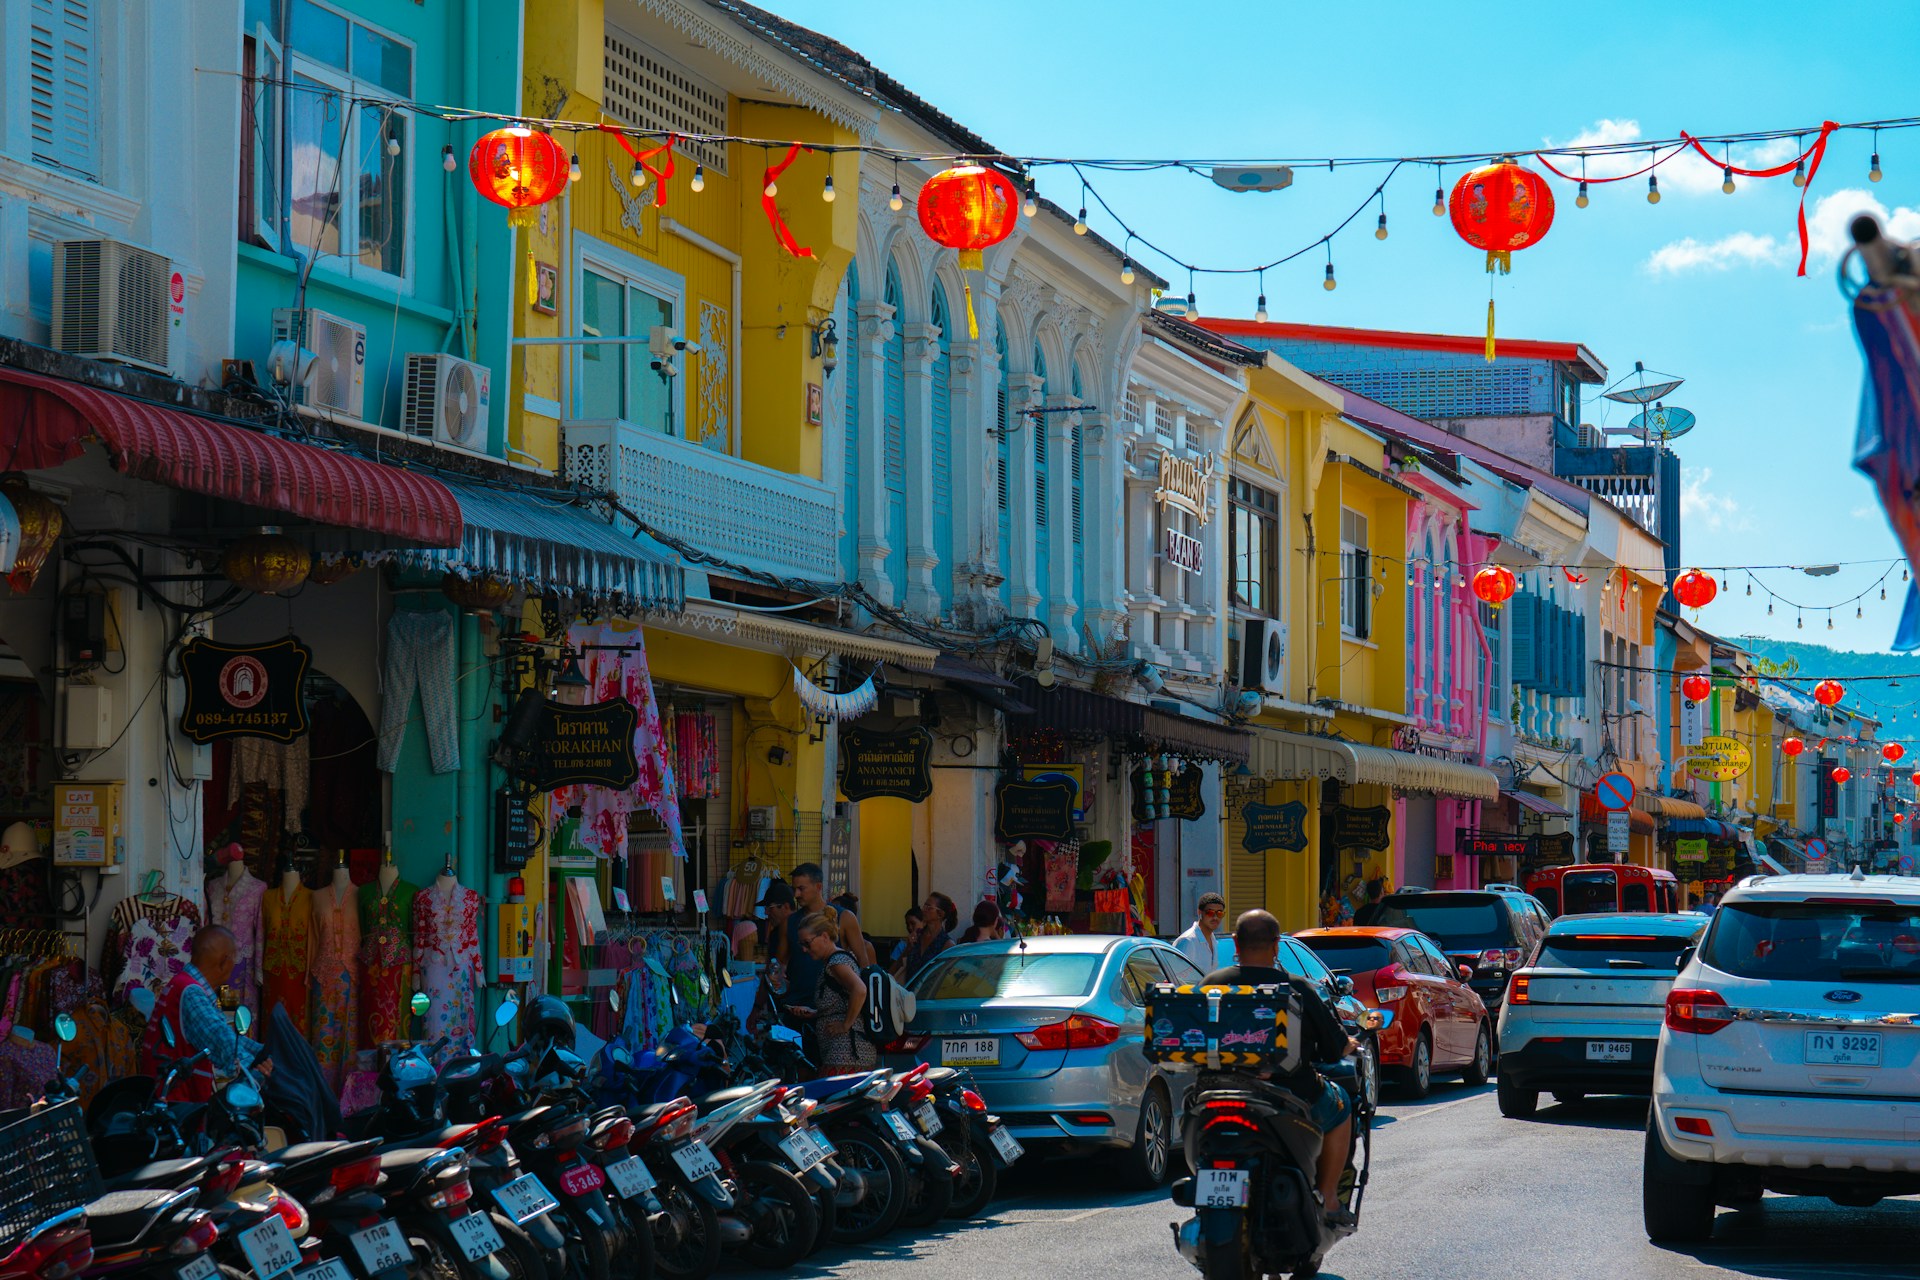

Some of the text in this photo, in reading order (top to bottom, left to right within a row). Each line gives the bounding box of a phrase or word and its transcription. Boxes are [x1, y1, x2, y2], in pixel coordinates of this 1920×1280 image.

[1167, 528, 1194, 571] BAAN
[195, 712, 288, 725] 089-4745137
[541, 739, 621, 754] TORAKHAN
[857, 766, 916, 776] ANANPANICH
[69, 794, 91, 802] CAT
[70, 807, 92, 815] CAT
[1831, 990, 1854, 1001] Ford
[975, 1041, 994, 1052] 188
[1608, 1043, 1631, 1053] 9465
[1842, 1037, 1877, 1051] 9292
[691, 1161, 718, 1180] 4442
[622, 1179, 651, 1197] 6457
[1207, 1195, 1235, 1206] 565
[518, 1199, 546, 1218] 3467
[469, 1238, 500, 1259] 2191
[263, 1250, 295, 1275] 7642
[376, 1252, 402, 1270] 668
